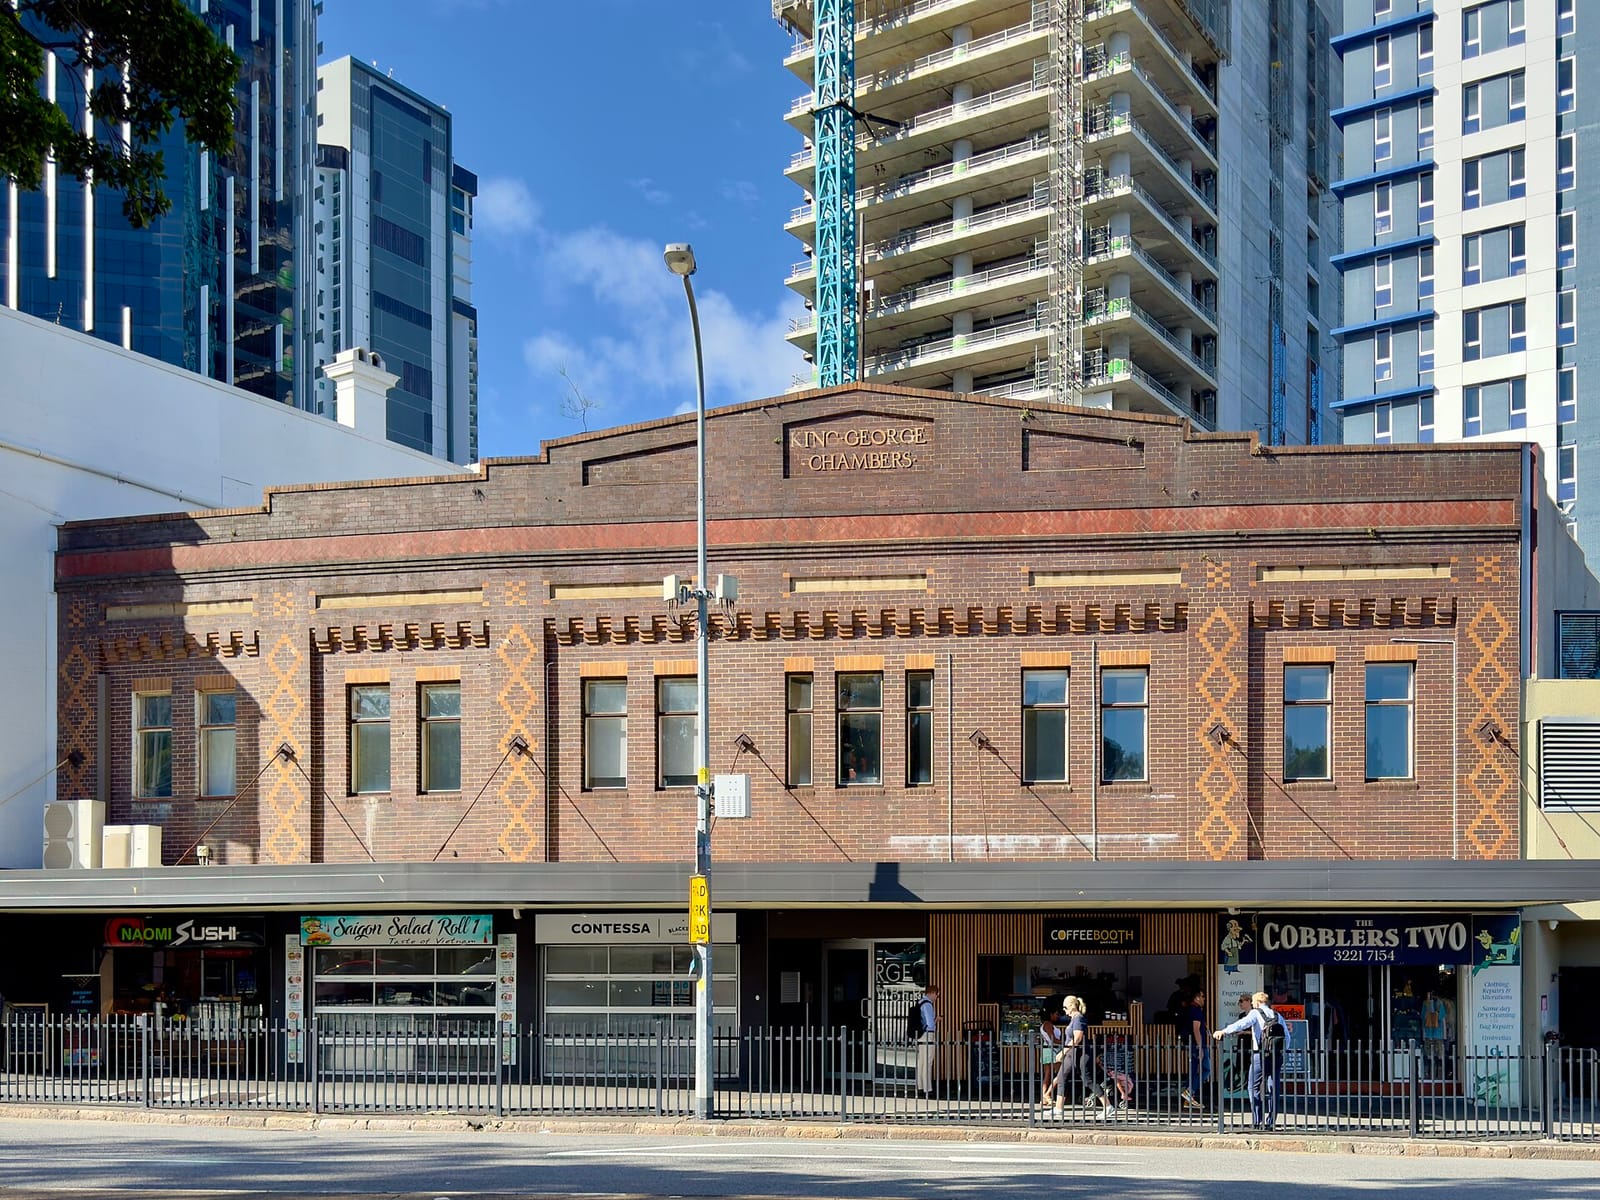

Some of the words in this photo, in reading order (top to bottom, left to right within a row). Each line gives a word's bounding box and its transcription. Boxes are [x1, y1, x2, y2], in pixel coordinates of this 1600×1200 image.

[845, 427, 927, 445] GEORGE
[809, 452, 912, 471] CHAMBERS
[333, 917, 383, 940] Saigon
[387, 917, 435, 936] Salad
[437, 917, 470, 936] Roll
[571, 923, 651, 934] CONTESSA
[1355, 919, 1373, 927] THE
[121, 928, 172, 941] NAOMI
[169, 919, 236, 946] SUSHI
[1051, 929, 1133, 944] COFFEEBOOTH
[1263, 922, 1400, 951] COBBLERS
[1405, 922, 1467, 951] TWO
[1333, 950, 1363, 961] 3221
[1367, 950, 1395, 961] 7154
[876, 963, 913, 982] RGE
